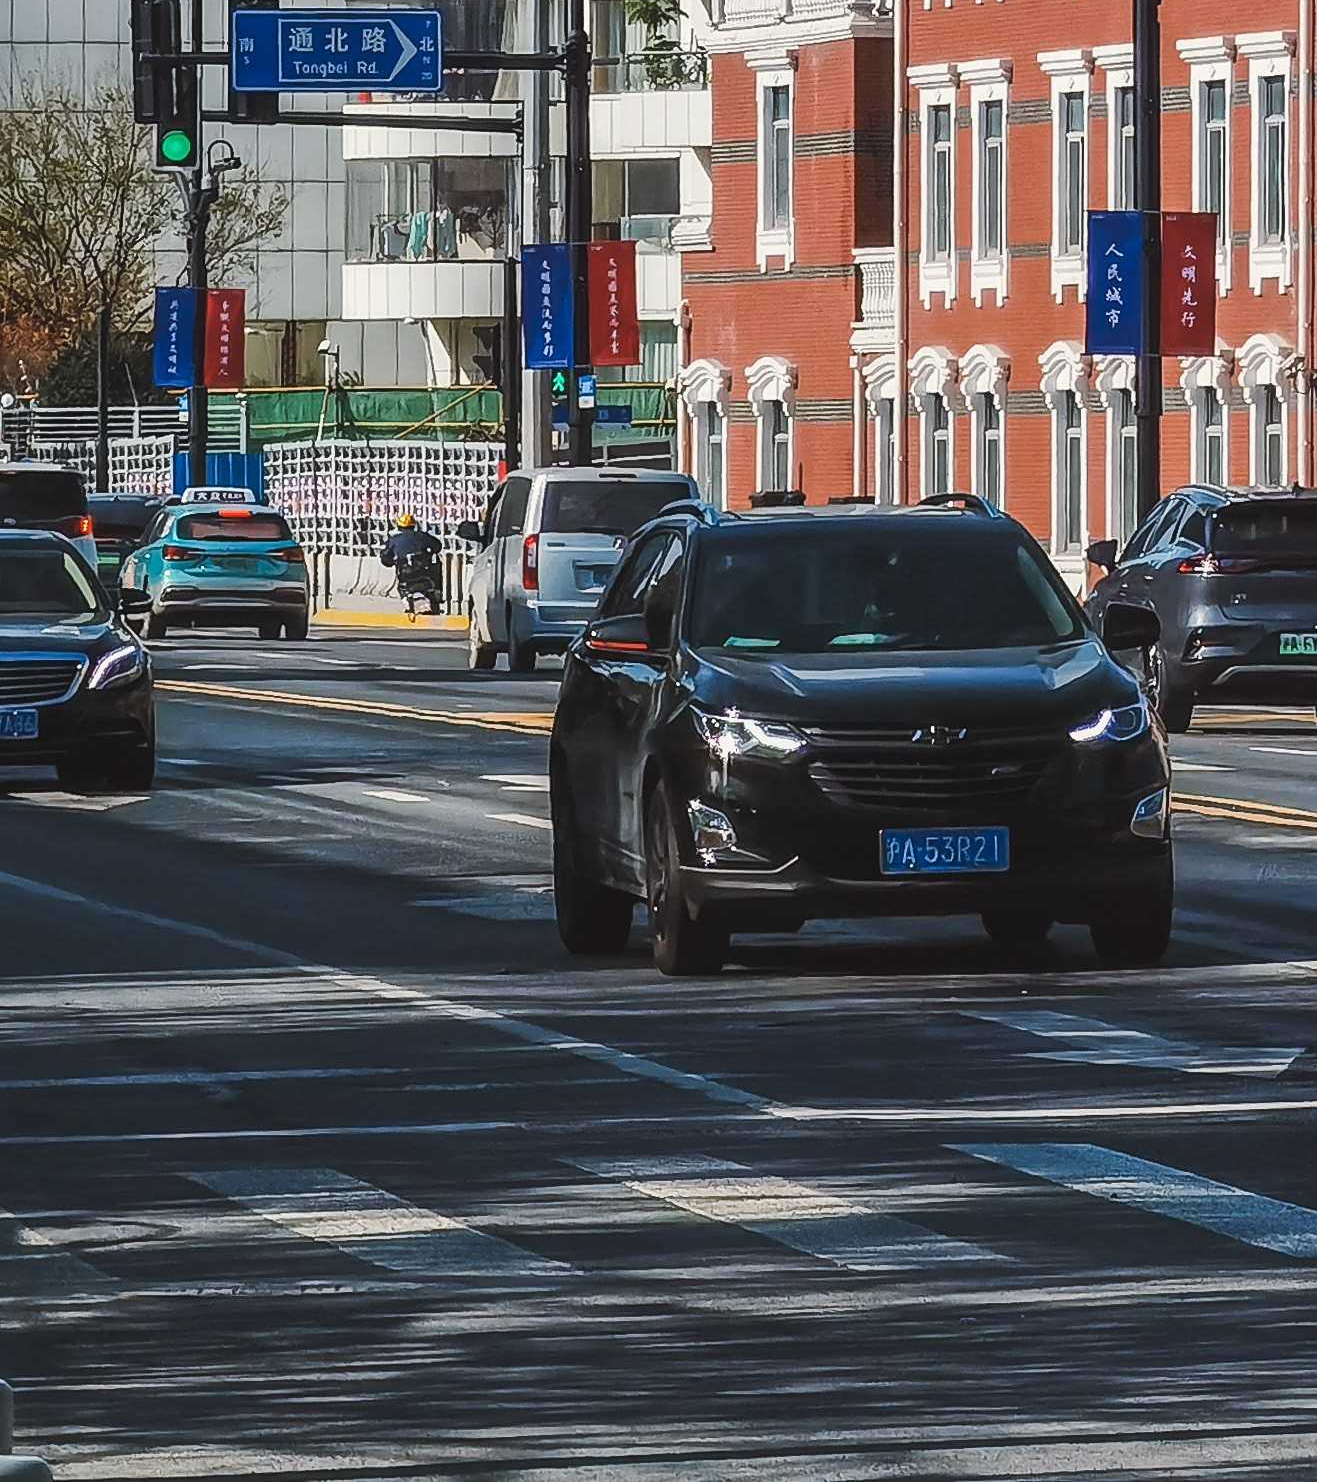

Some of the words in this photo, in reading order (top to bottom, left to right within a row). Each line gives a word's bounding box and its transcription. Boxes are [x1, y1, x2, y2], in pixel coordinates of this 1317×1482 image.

[288, 26, 388, 54] 通北路
[419, 36, 436, 53] 北
[292, 60, 349, 78] Tongbei
[1104, 242, 1125, 330] 人民城市
[1181, 244, 1198, 329] 文明先行
